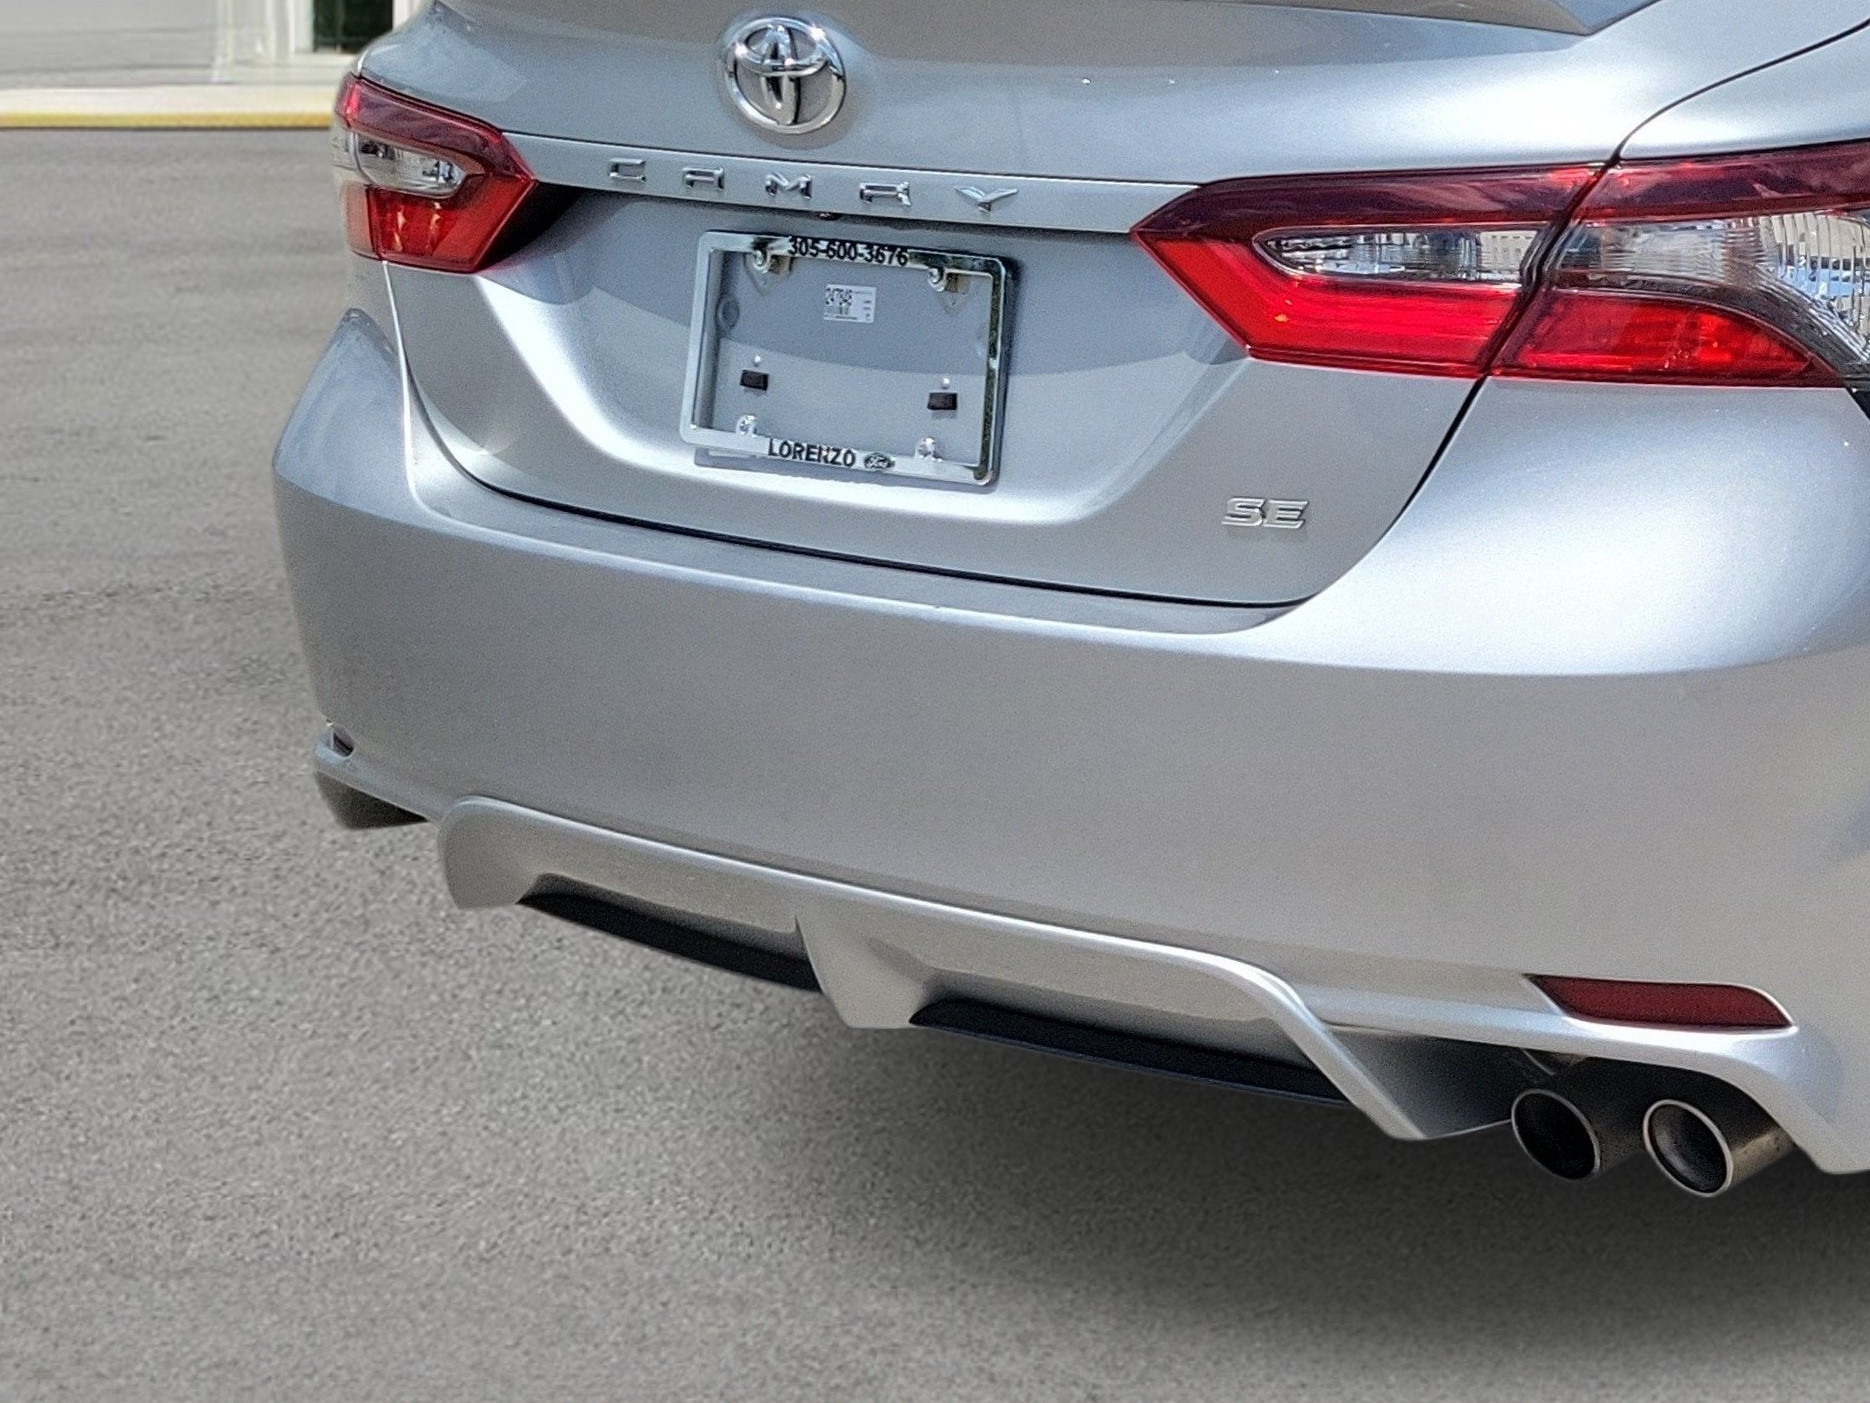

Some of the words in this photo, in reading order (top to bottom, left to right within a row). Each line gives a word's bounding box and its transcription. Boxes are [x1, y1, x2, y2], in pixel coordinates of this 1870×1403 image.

[607, 158, 1020, 213] CAMRY
[788, 236, 909, 266] 305-600-3676
[768, 438, 857, 467] LORENZO
[1221, 496, 1309, 530] SE
